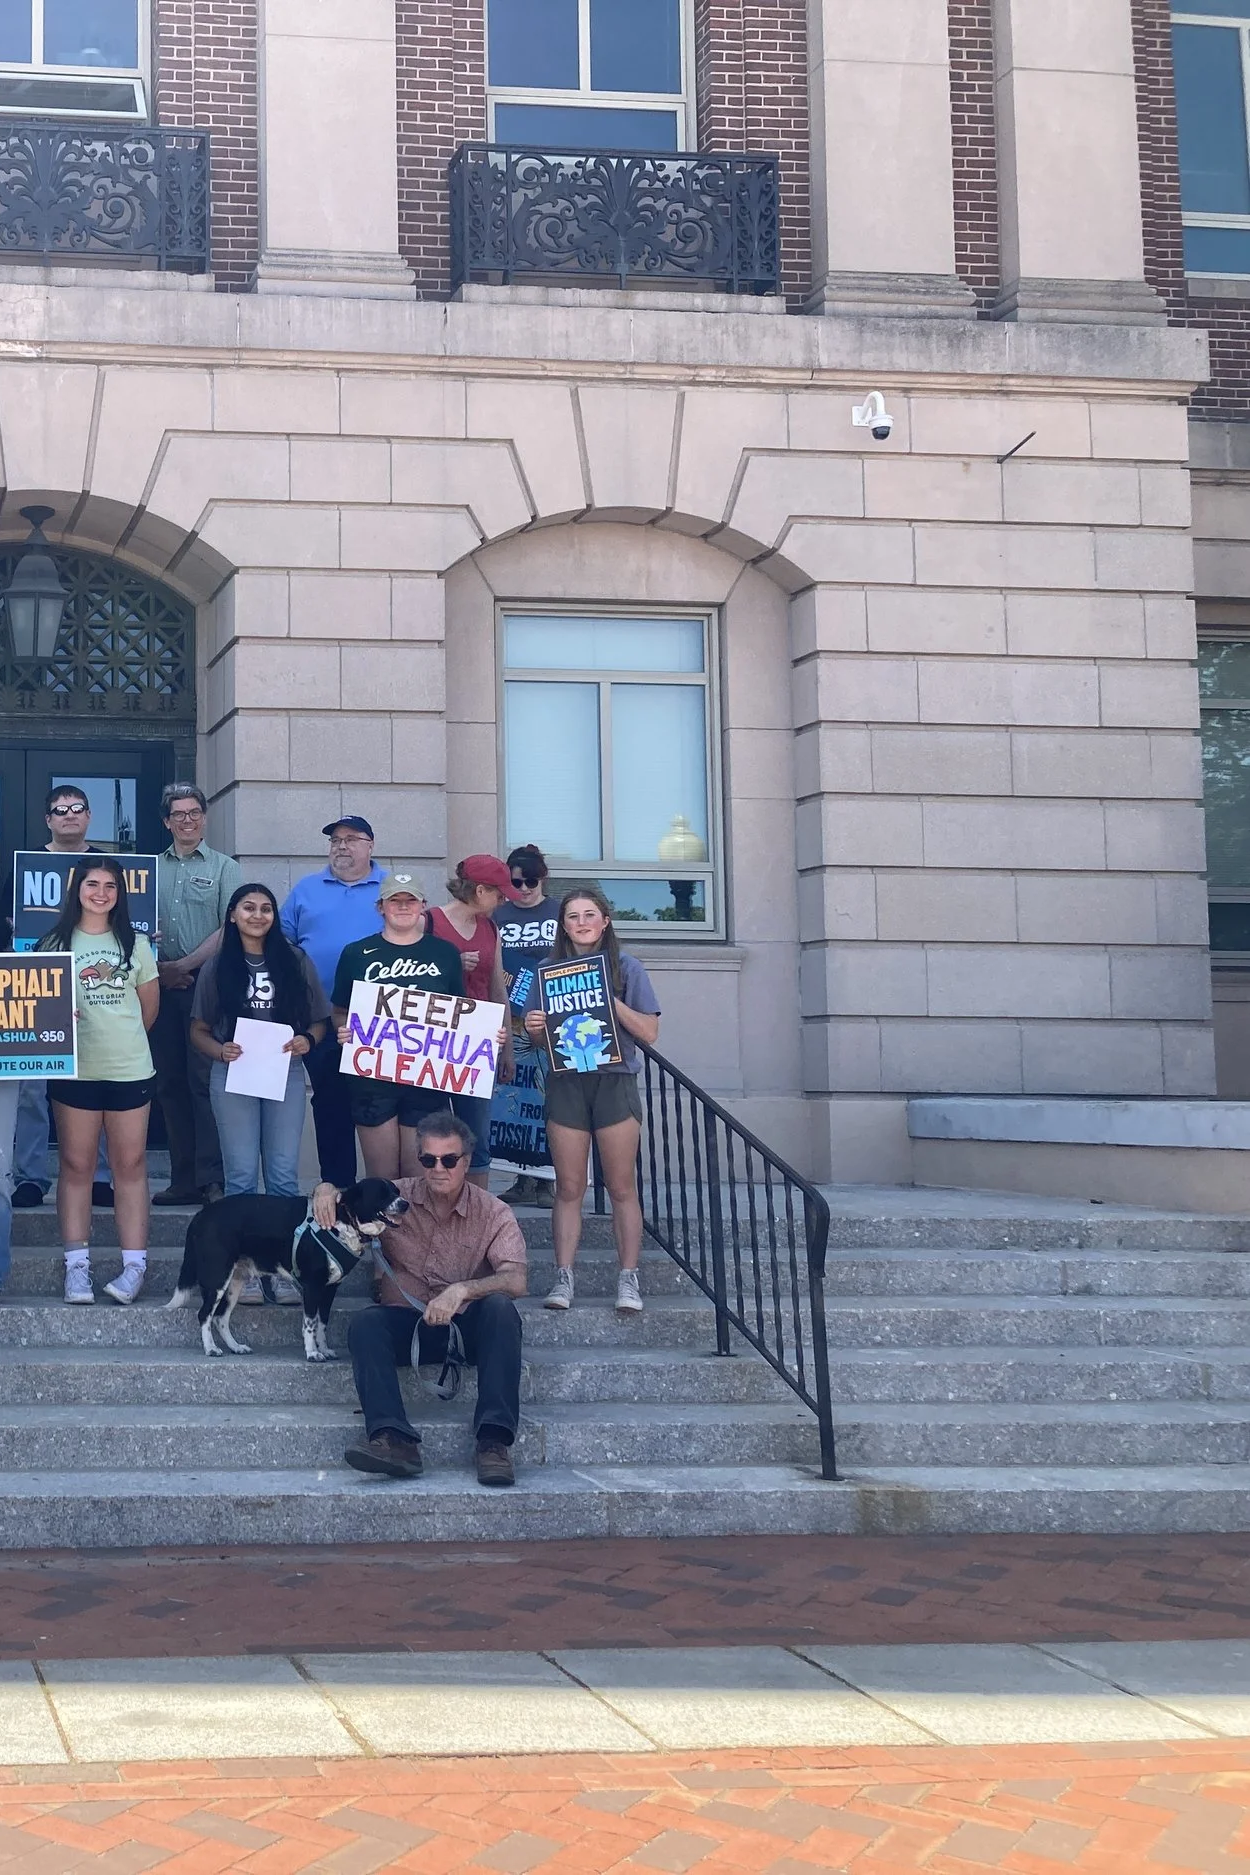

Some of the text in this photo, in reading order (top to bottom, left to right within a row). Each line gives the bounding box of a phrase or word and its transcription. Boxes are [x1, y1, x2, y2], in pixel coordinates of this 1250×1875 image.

[23, 870, 61, 907] NO
[364, 958, 442, 983] Celtics
[546, 970, 566, 978] PEOPLE
[567, 965, 587, 973] POWER
[545, 971, 601, 997] CLIMATE
[374, 985, 477, 1030] KEEP
[548, 988, 605, 1014] JUSTICE
[349, 1012, 495, 1072] NASHUA
[19, 1060, 43, 1071] OUR
[46, 1060, 65, 1070] AIR
[352, 1046, 481, 1095] CLEAN!
